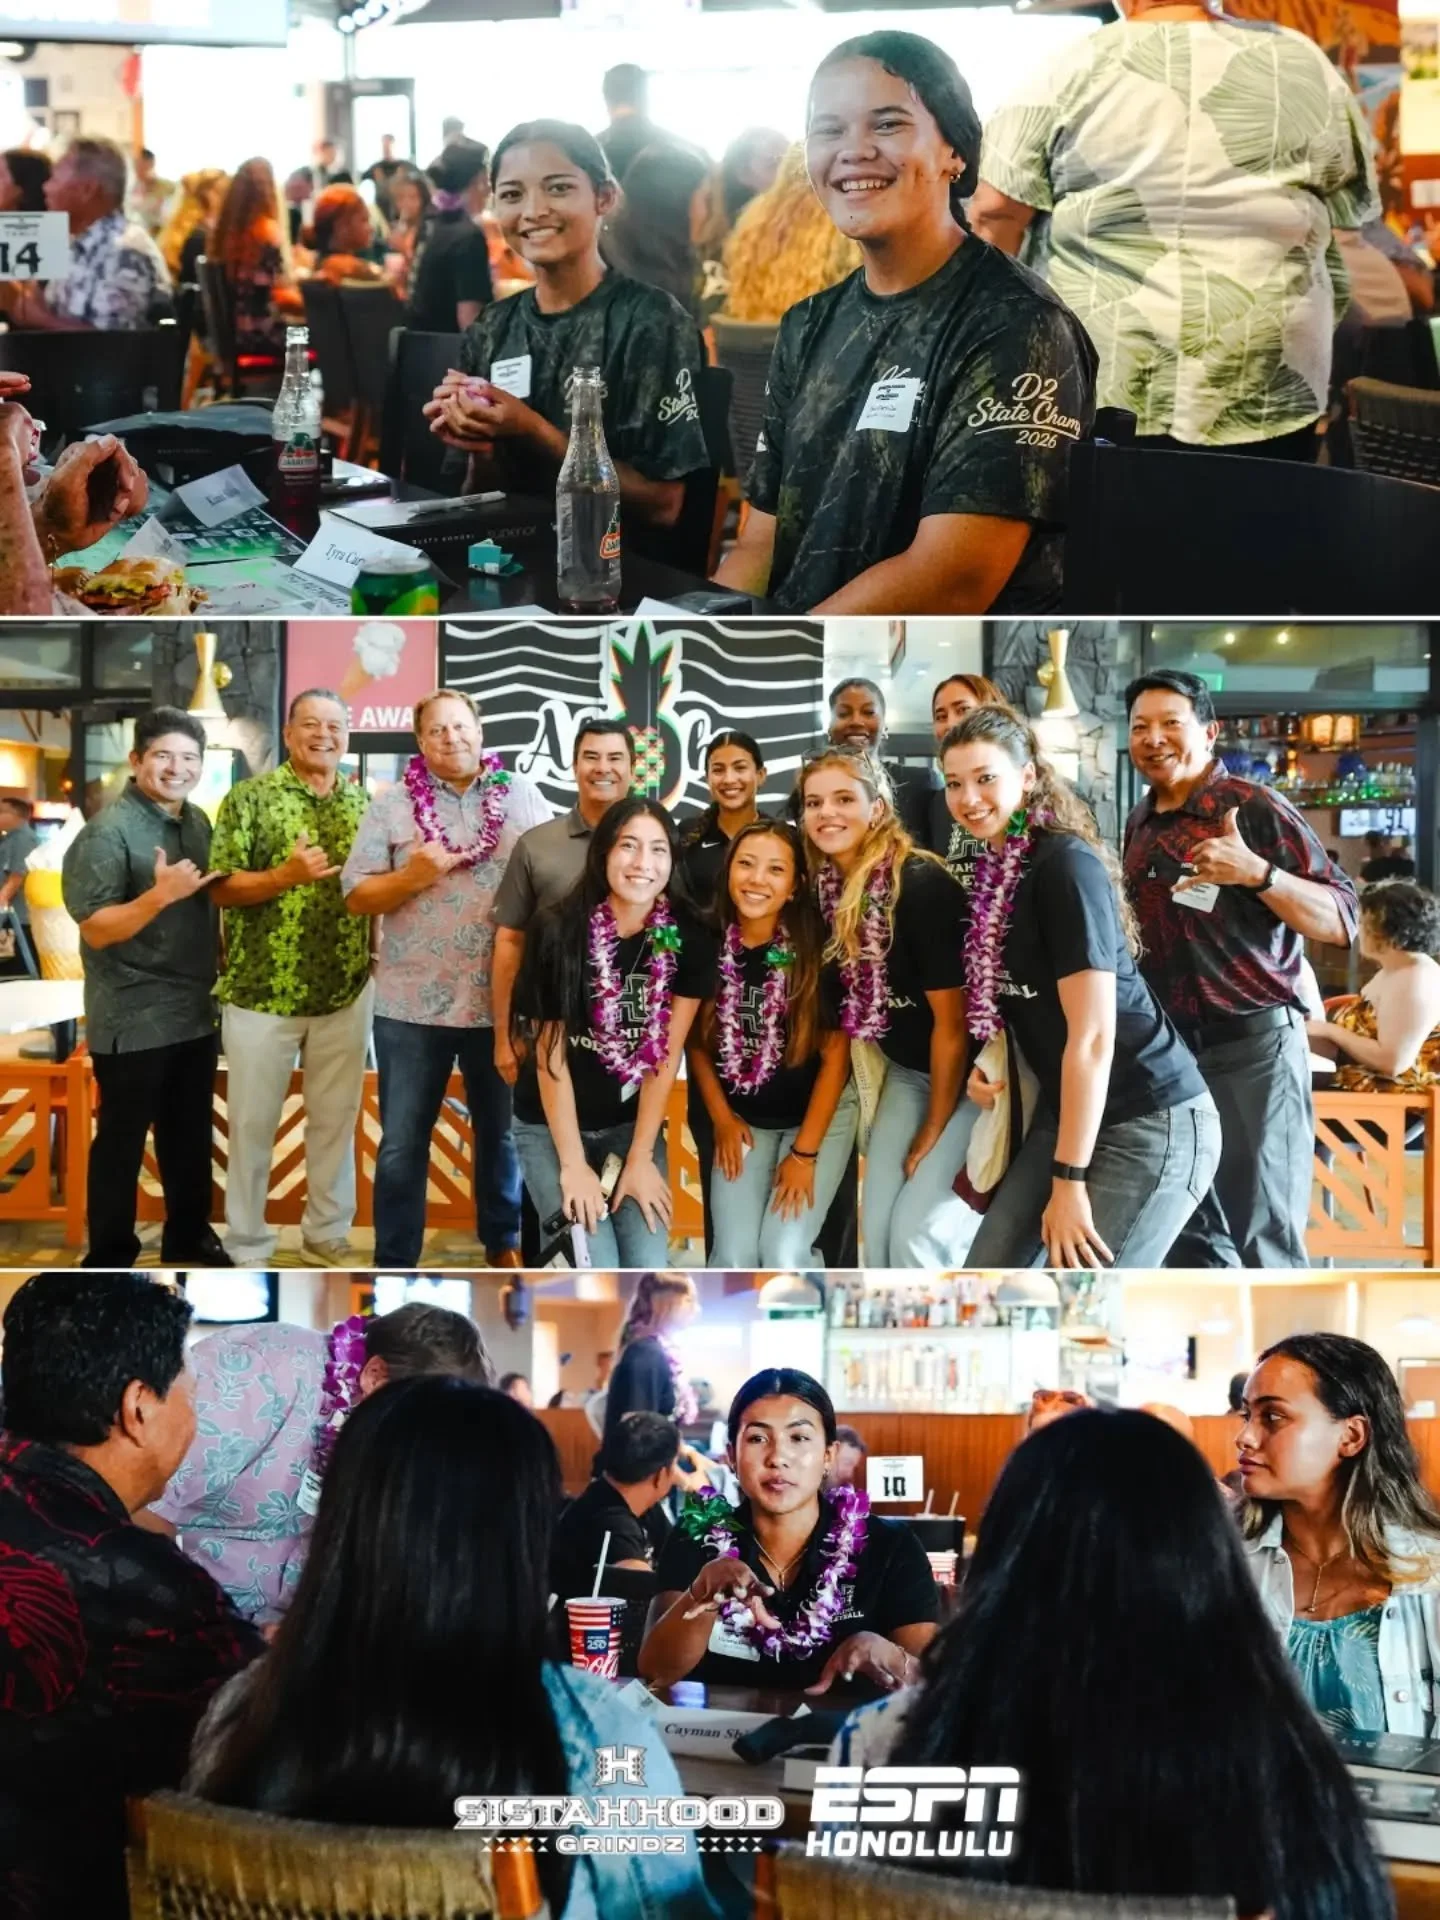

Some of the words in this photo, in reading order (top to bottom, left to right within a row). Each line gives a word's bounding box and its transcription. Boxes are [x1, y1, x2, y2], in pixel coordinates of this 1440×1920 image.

[0, 242, 43, 275] 14
[1012, 373, 1058, 401] D2
[967, 397, 1031, 427] State
[1015, 430, 1058, 448] 2026
[326, 543, 346, 560] Tyra
[359, 706, 415, 728] AWA
[882, 1476, 906, 1497] 10
[664, 1723, 721, 1739] Cayman
